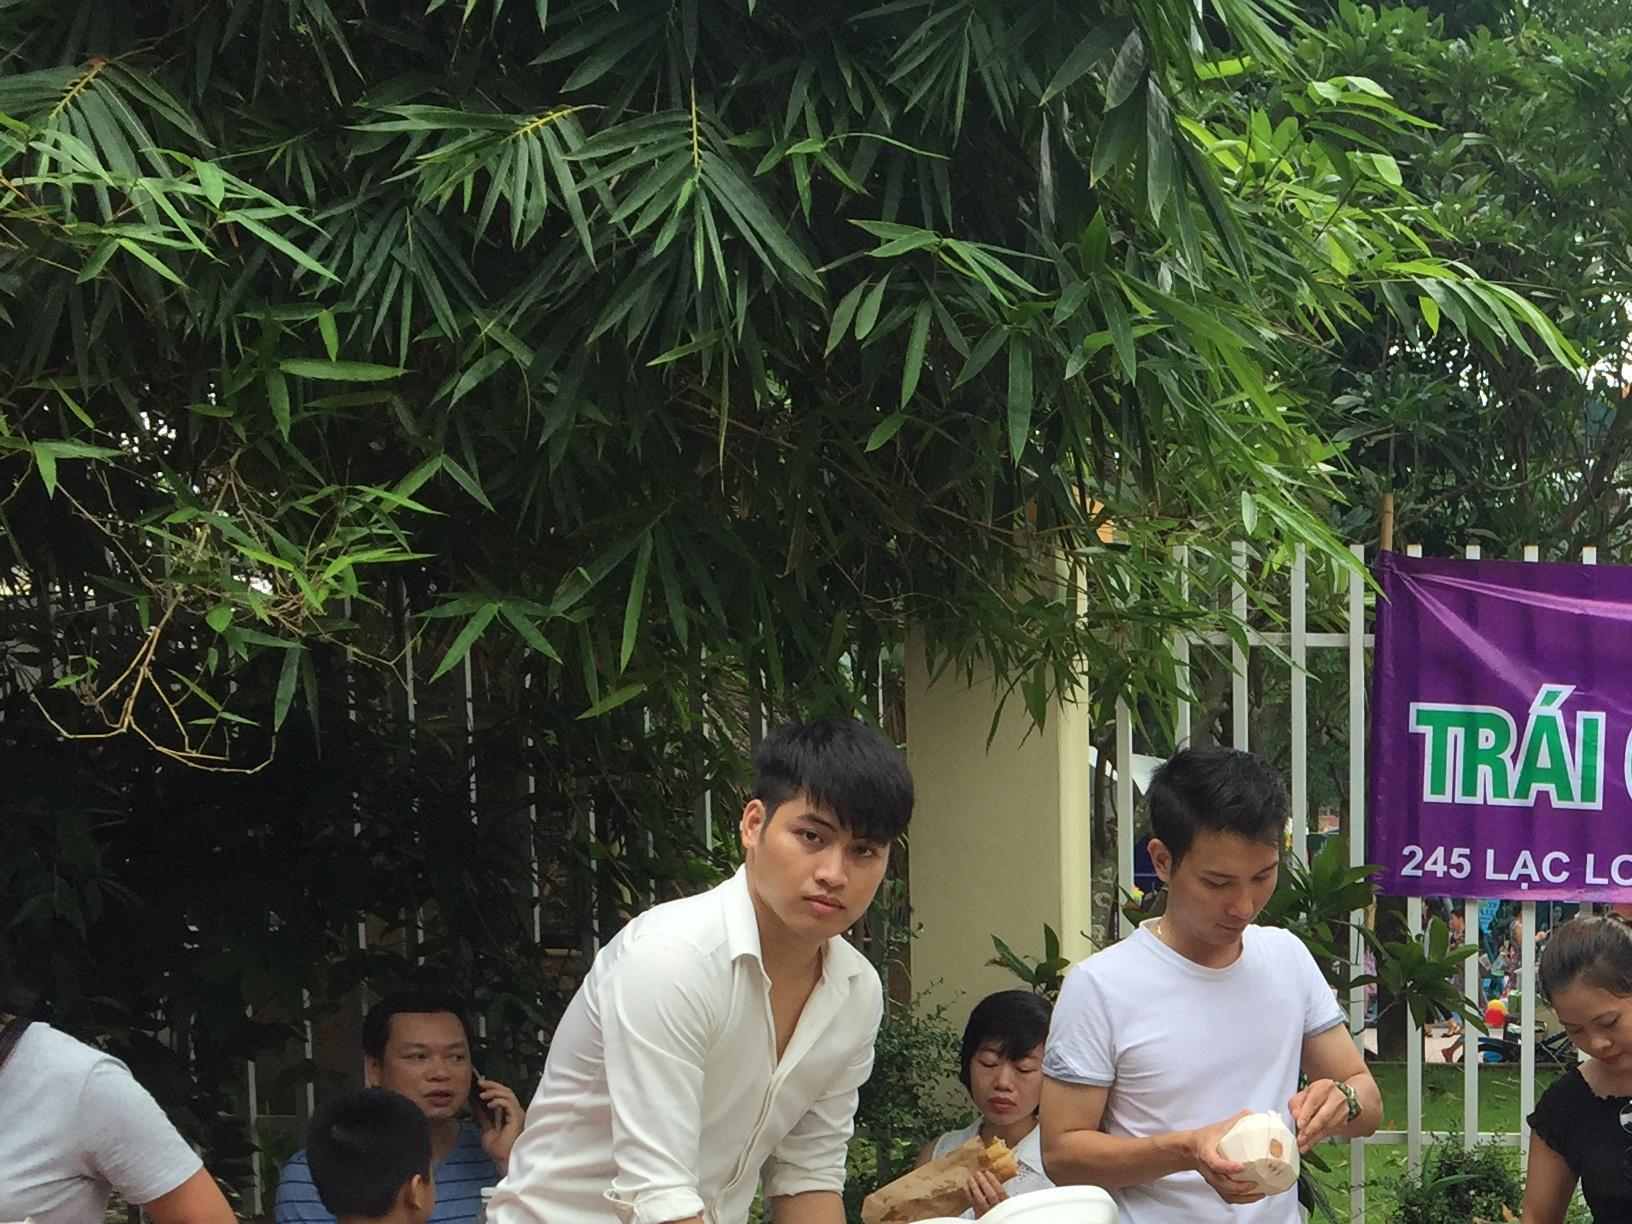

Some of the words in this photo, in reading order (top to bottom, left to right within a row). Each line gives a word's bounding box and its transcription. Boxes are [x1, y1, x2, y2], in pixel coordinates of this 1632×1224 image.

[1409, 684, 1606, 811] TRÁI
[1401, 845, 1472, 879] 245
[1484, 848, 1571, 889] LẠC
